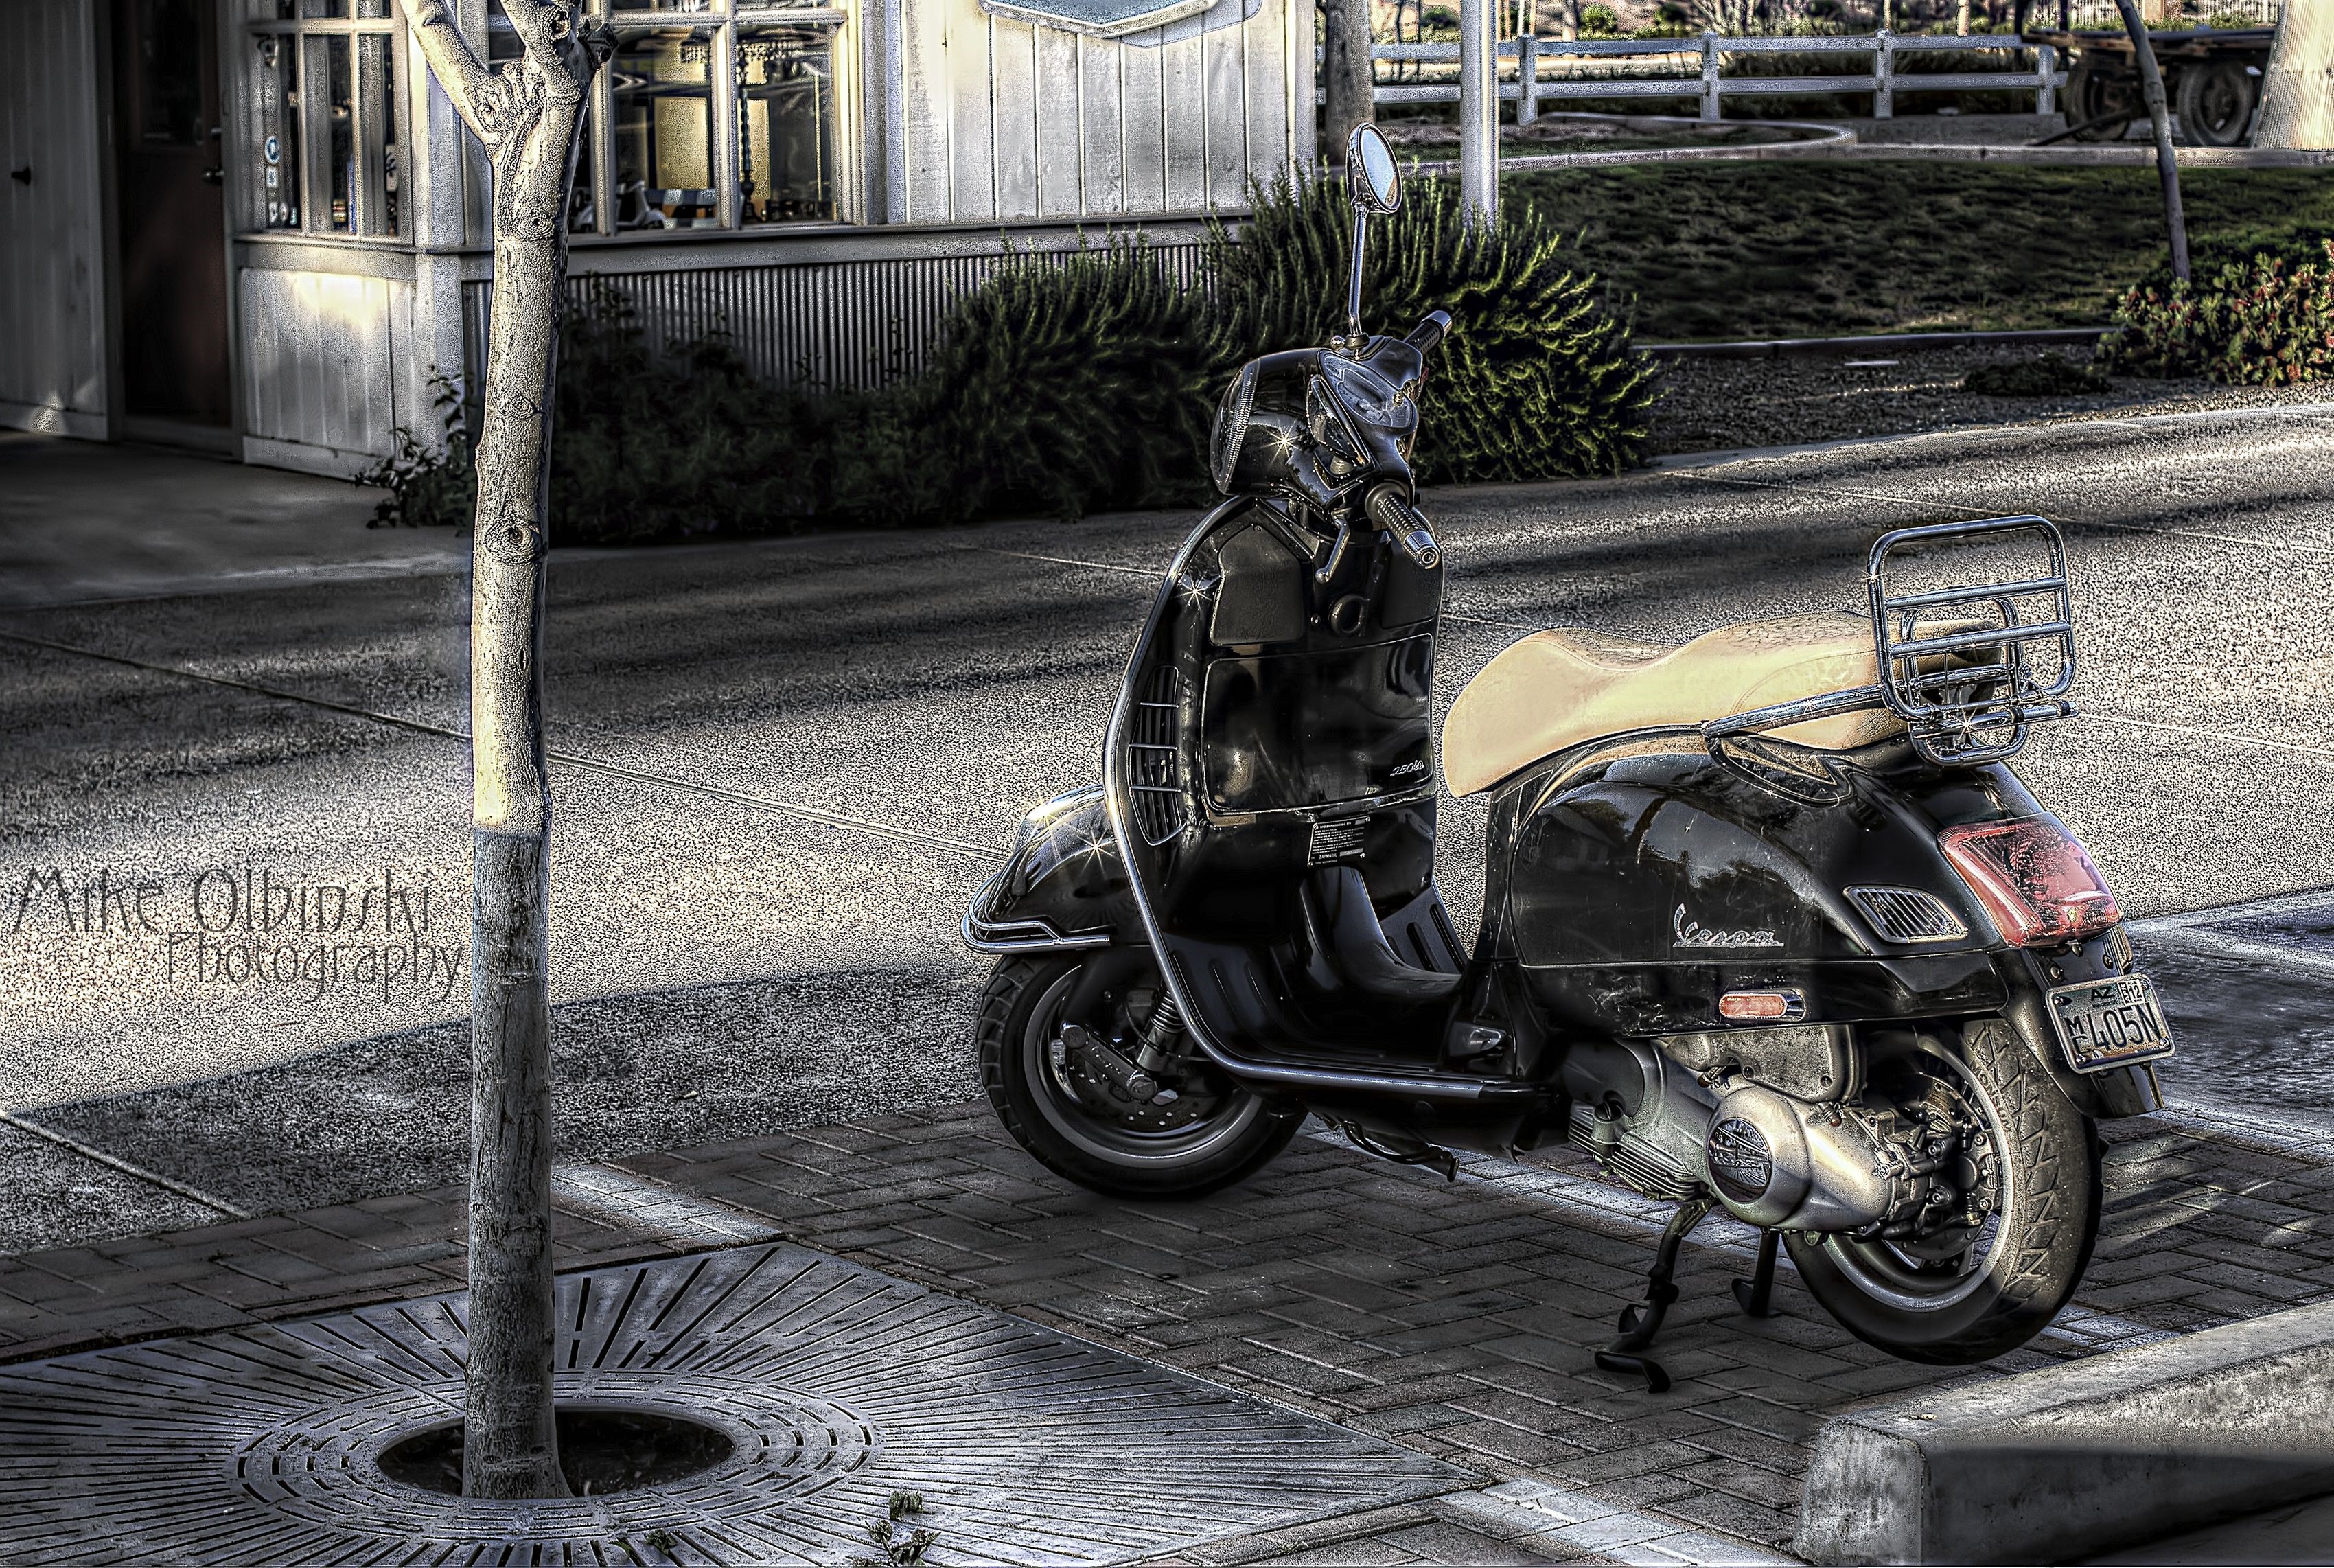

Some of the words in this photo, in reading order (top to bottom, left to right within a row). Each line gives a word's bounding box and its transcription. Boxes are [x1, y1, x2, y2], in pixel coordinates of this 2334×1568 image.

[1672, 903, 1785, 949] Vespa
[2090, 985, 2116, 1002] AZ
[2129, 984, 2142, 999] 12
[2085, 1002, 2163, 1051] 405N
